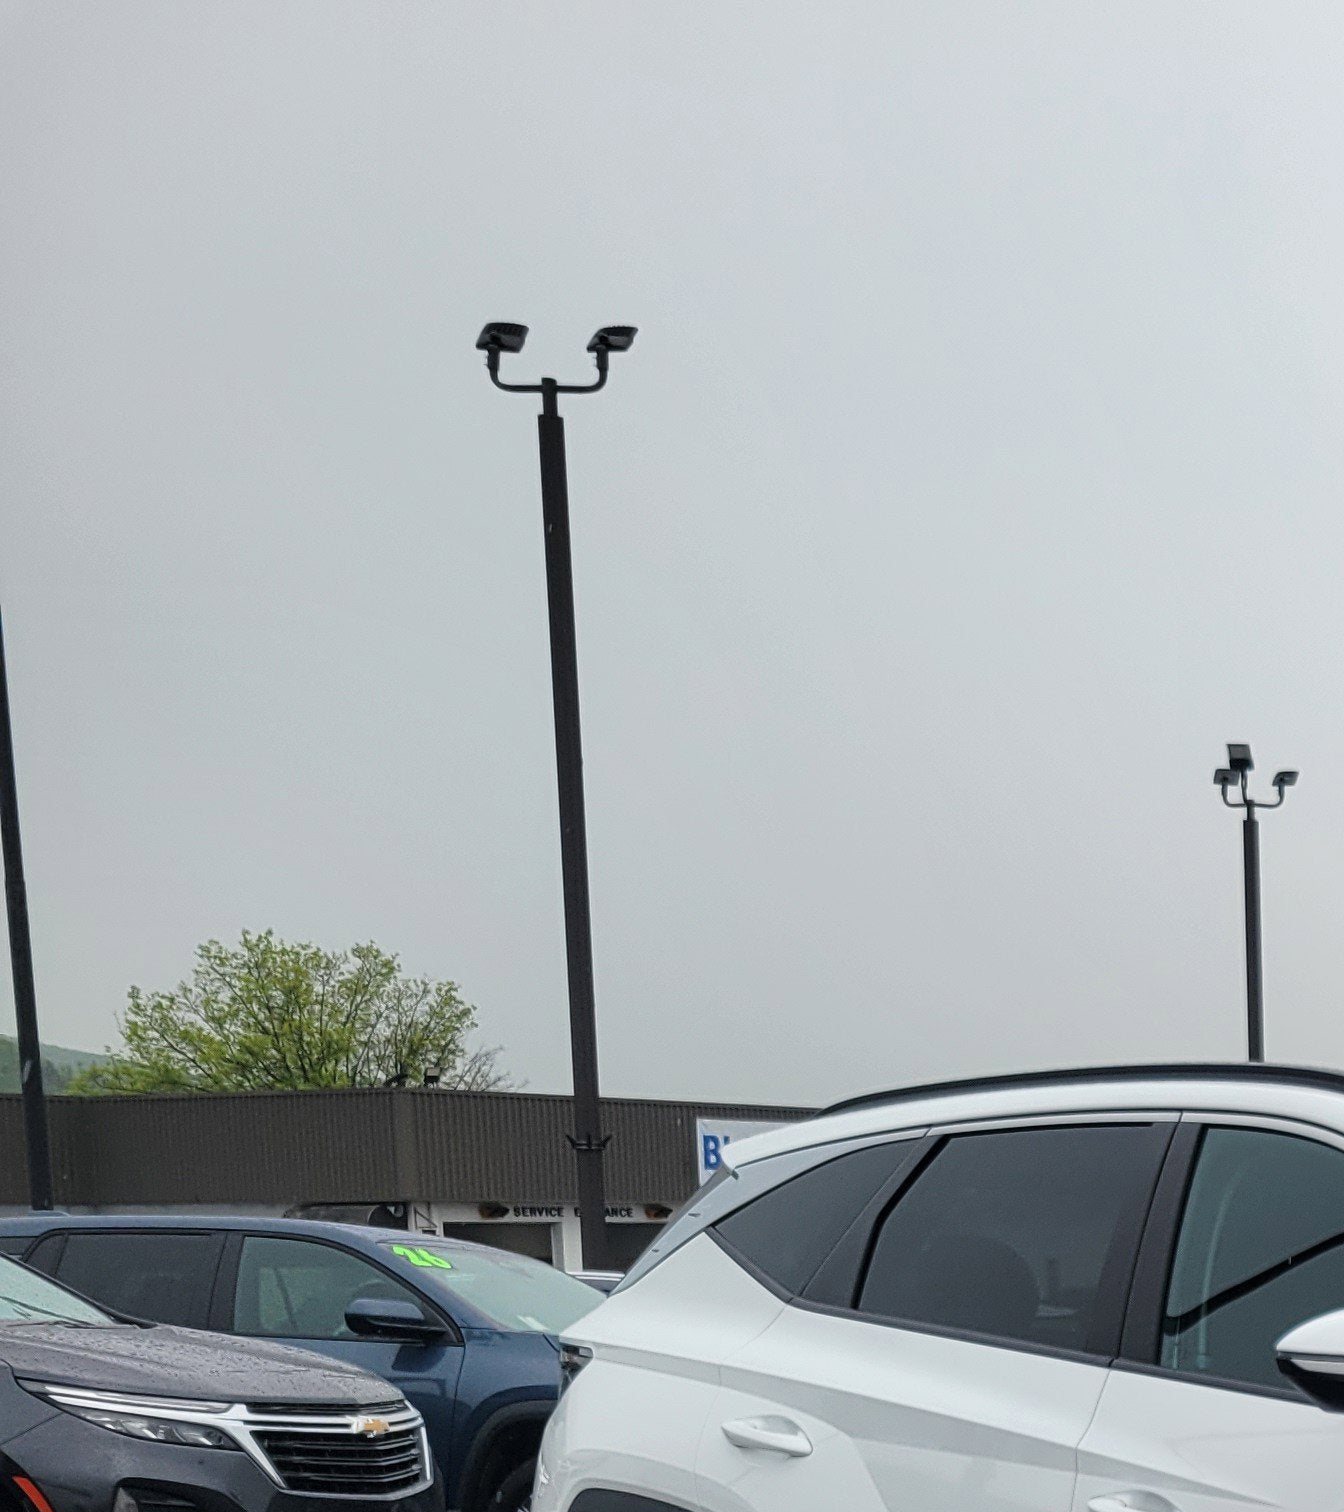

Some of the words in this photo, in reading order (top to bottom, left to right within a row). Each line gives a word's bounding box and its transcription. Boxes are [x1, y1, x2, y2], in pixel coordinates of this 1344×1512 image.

[513, 1205, 565, 1218] SERVICE
[574, 1205, 634, 1218] EANCE
[392, 1245, 453, 1269] 26
